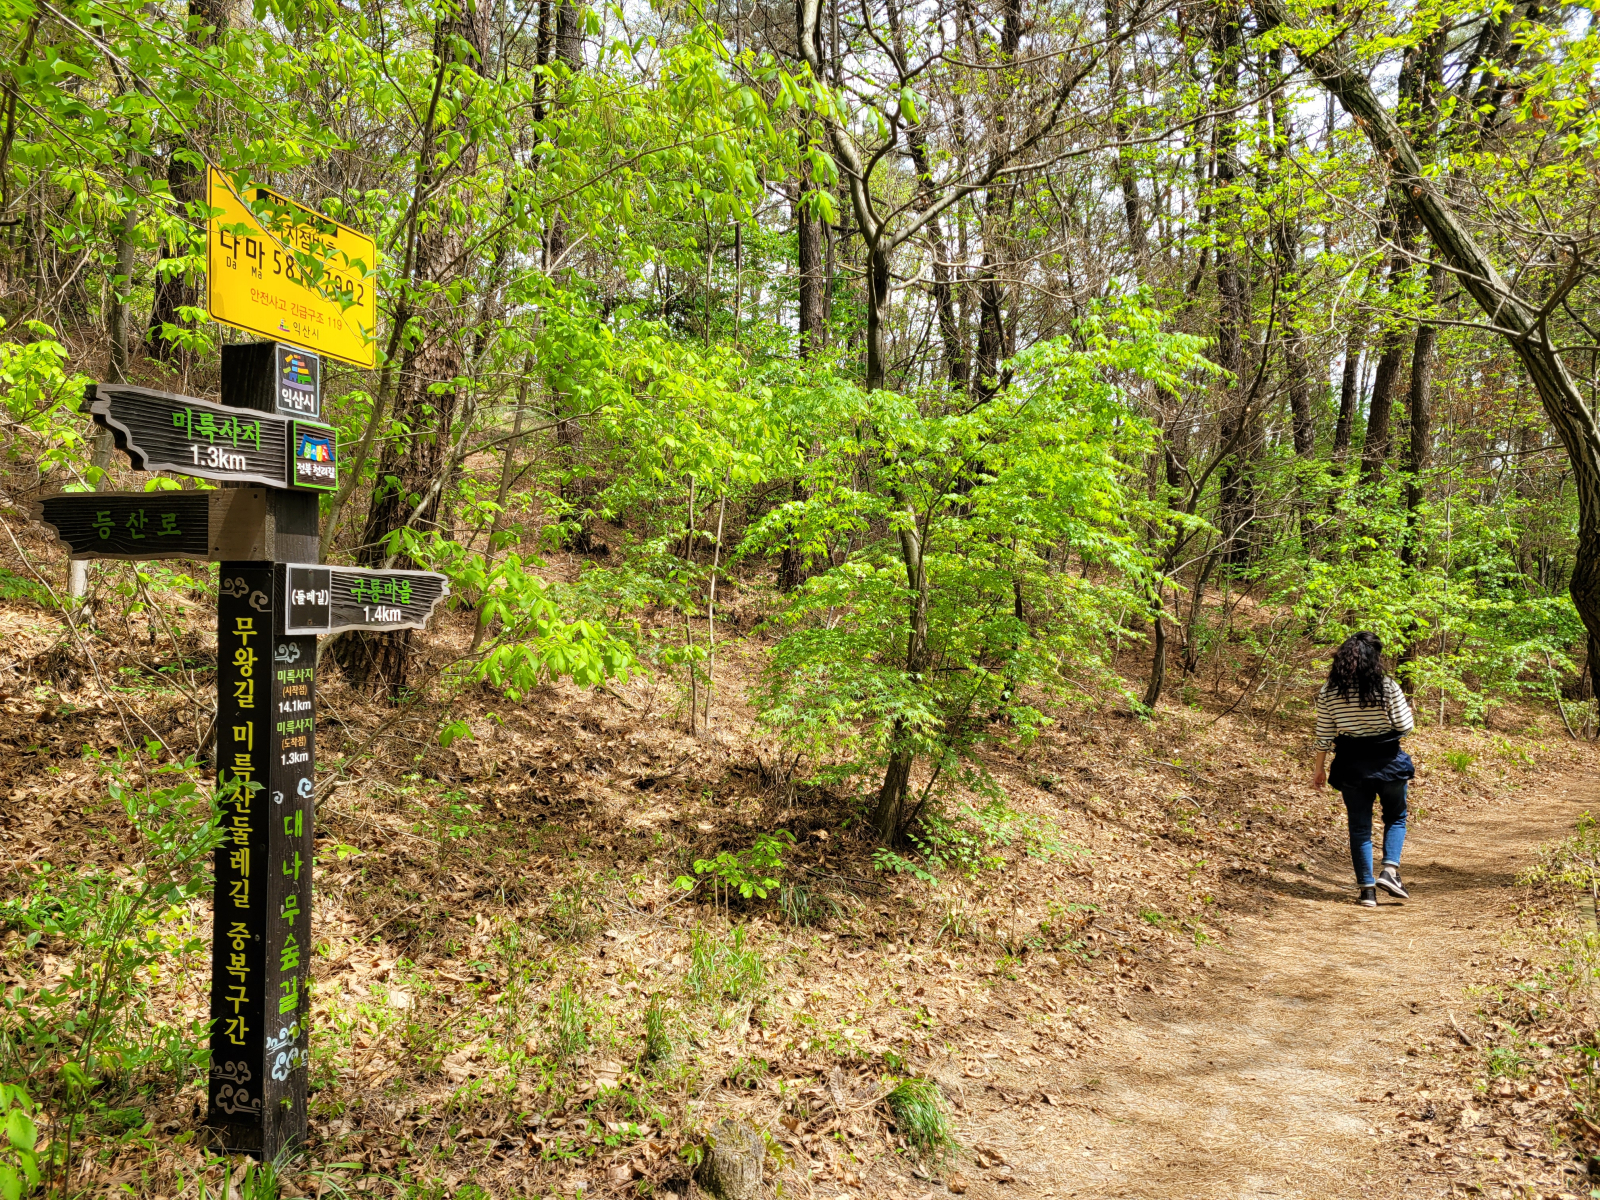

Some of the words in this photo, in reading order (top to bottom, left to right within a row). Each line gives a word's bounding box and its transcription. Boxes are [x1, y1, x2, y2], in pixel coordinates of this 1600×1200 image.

[226, 256, 237, 270] Da
[251, 266, 263, 280] Ma
[250, 288, 288, 312] 안전사고
[290, 302, 325, 325] 긴급구조
[327, 316, 344, 331] 119
[292, 321, 319, 341] 익산시
[281, 388, 315, 413] 익산시
[172, 407, 260, 451] 미륵사지
[190, 444, 246, 471] 1.3km
[296, 462, 312, 476] 전북
[312, 464, 336, 479] 천리길
[91, 508, 182, 540] 등산로
[291, 588, 329, 606] (둘레길)
[350, 577, 413, 605] 구룡마을
[363, 605, 402, 622] 1.4km
[232, 617, 258, 709] 무왕길
[277, 667, 313, 685] 미륵사지
[282, 684, 308, 699] (시작점)
[278, 699, 312, 714] 14.1km
[276, 717, 313, 736] 미륵사지
[281, 735, 307, 751] (도착점)
[280, 751, 309, 766] 1.3km
[229, 720, 256, 909] 미륵산둘레길
[279, 809, 303, 1015] 대나무숲길
[223, 921, 252, 1046] 중복구간
